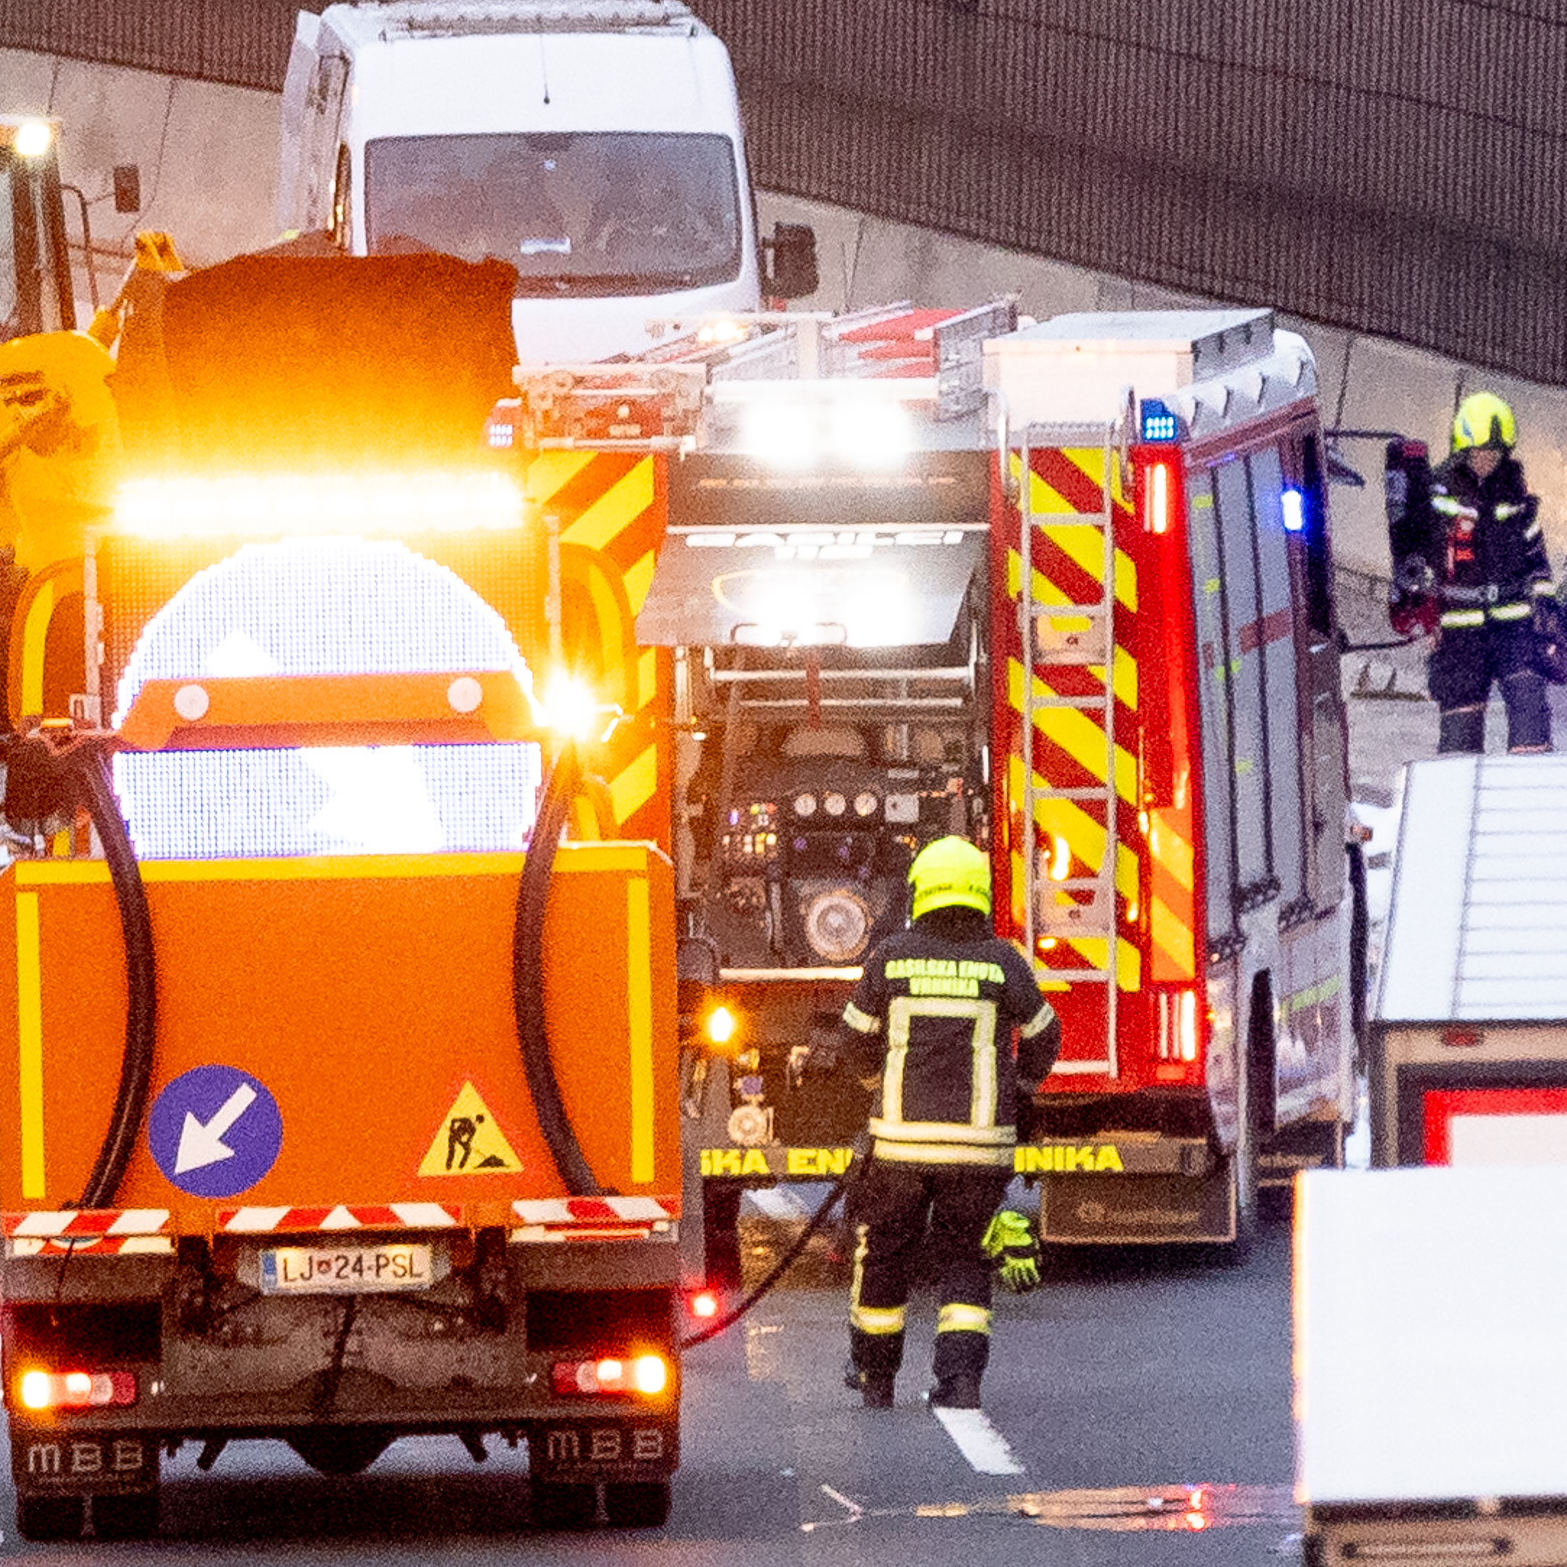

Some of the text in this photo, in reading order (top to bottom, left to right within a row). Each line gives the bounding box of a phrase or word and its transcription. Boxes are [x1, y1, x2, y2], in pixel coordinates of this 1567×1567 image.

[786, 1148, 854, 1175] EN
[282, 1253, 426, 1282] LJ 24-PSL
